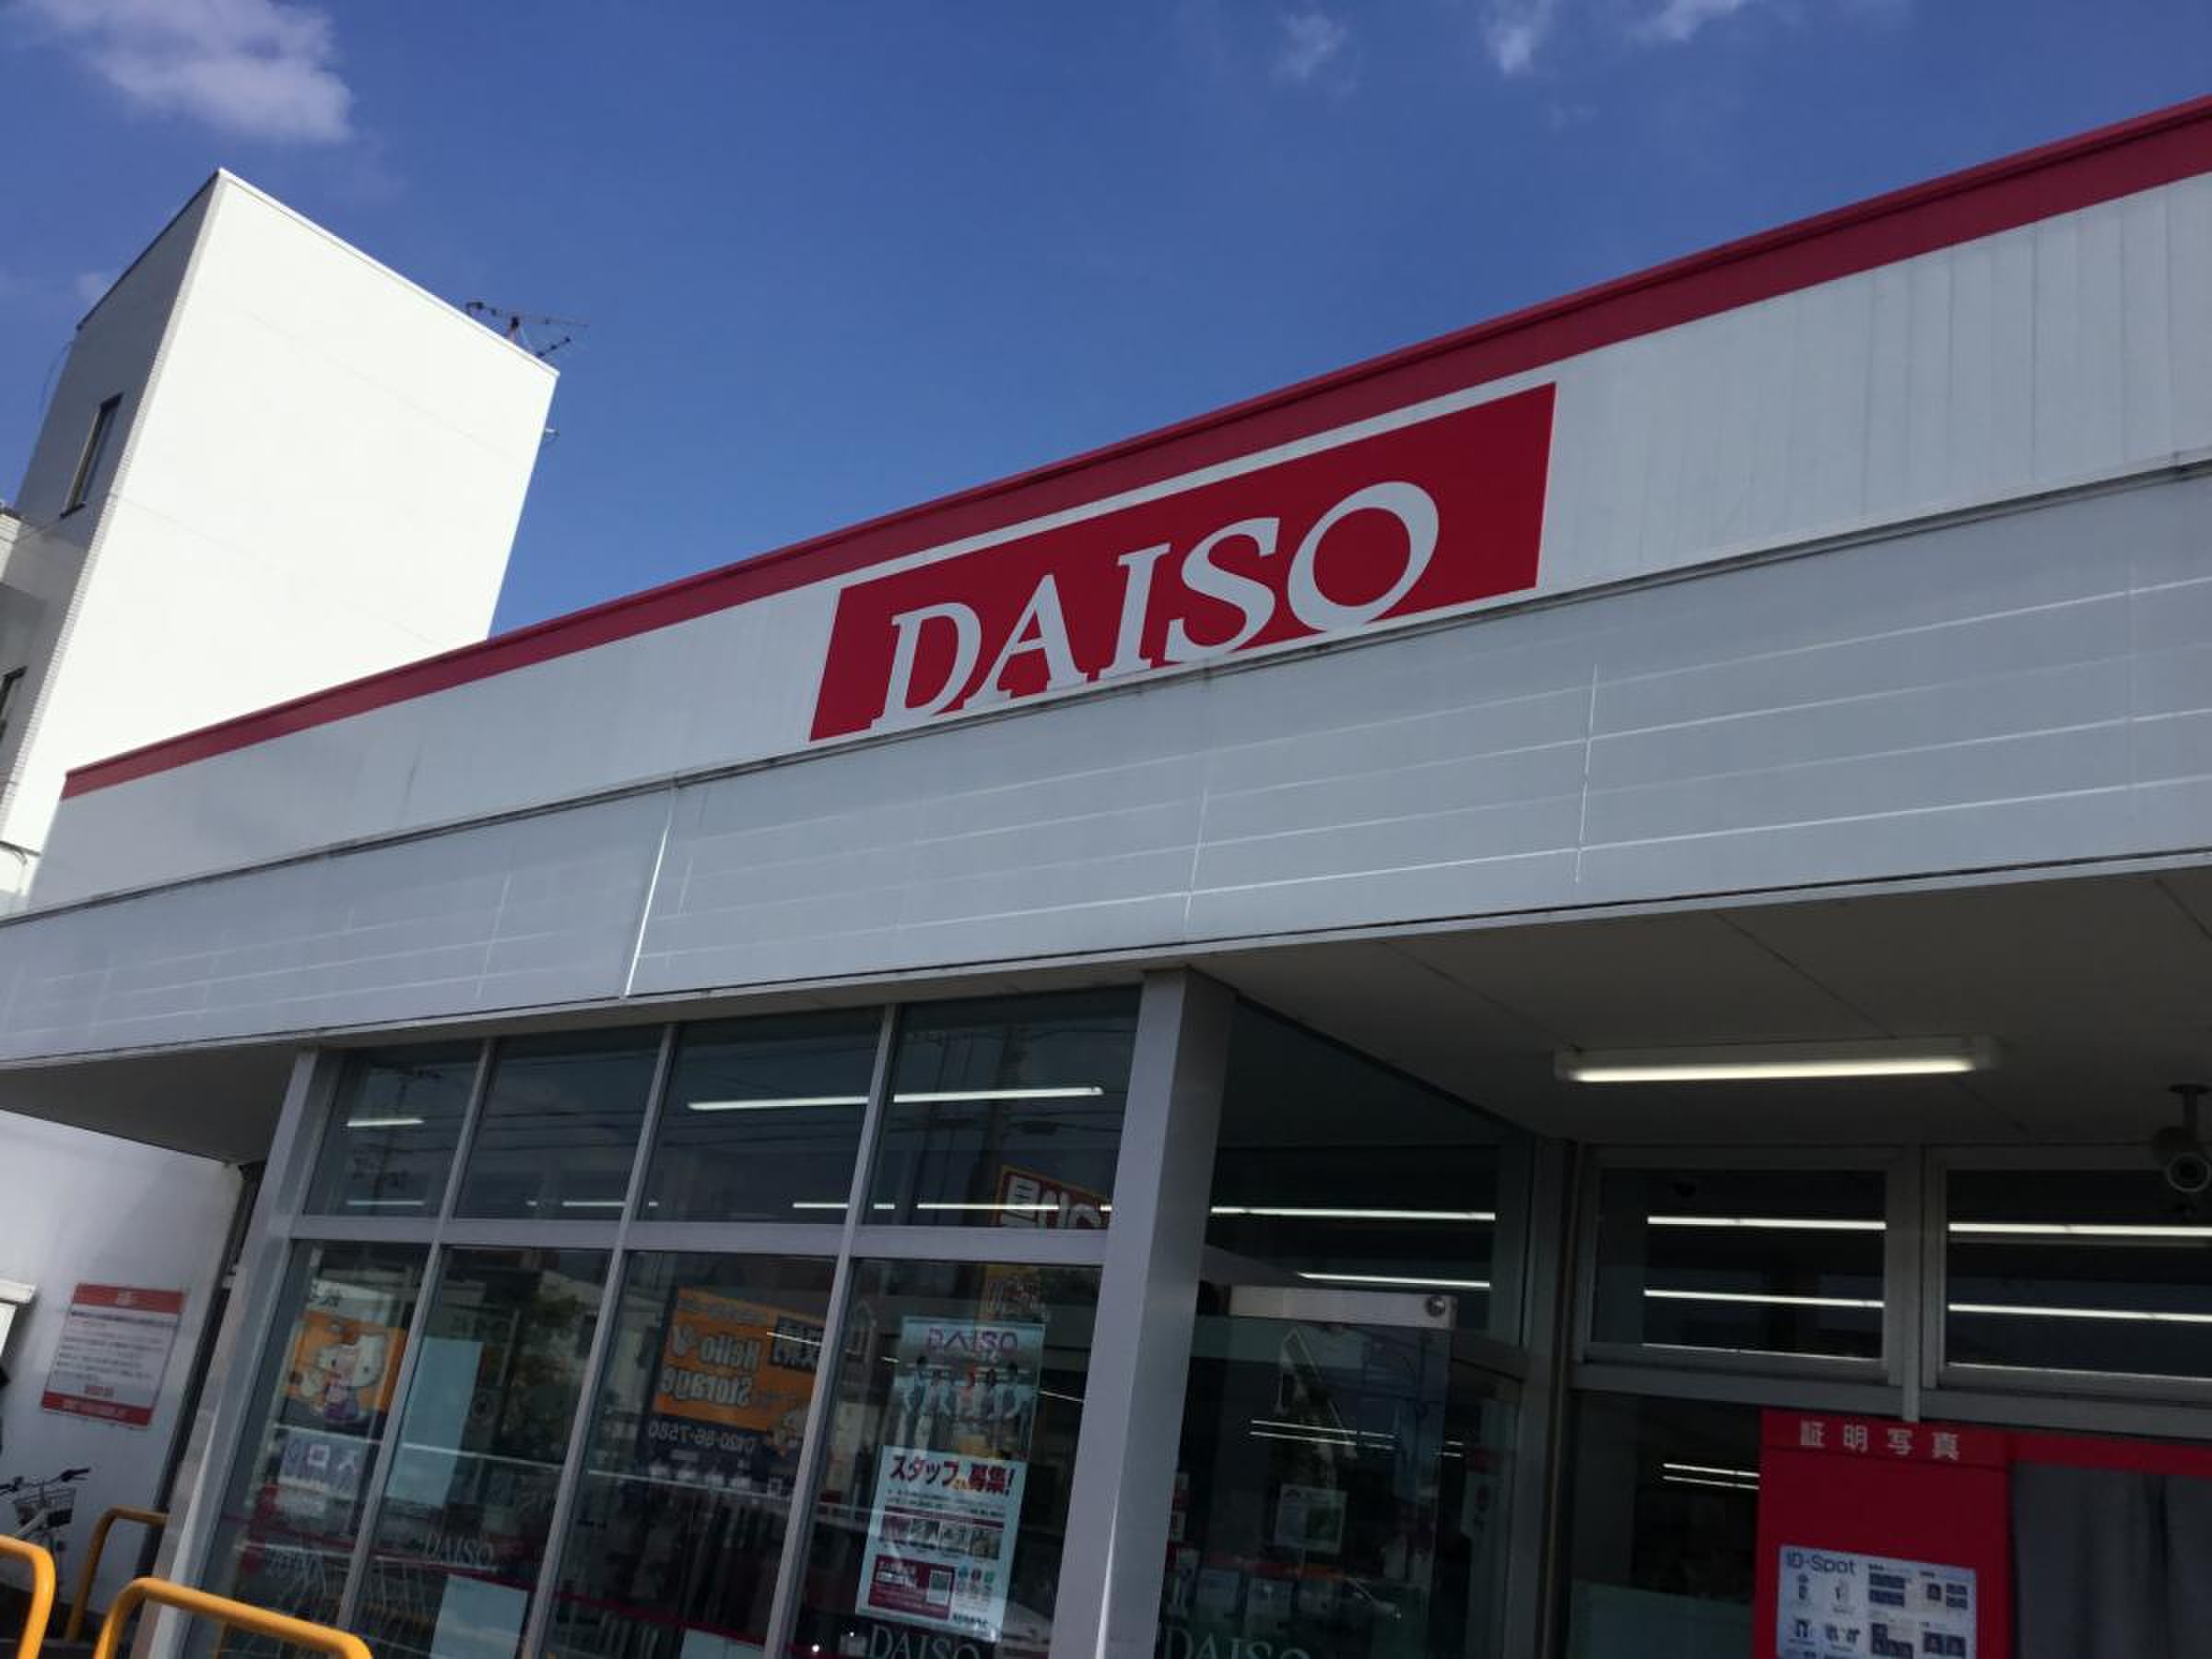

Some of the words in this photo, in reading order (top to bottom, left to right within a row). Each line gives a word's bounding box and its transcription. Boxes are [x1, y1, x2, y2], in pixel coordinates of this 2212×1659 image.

[869, 480, 1440, 730] DAISO
[1798, 1419, 1960, 1461] 証明写真
[1786, 1550, 1856, 1576] ID-Spot
